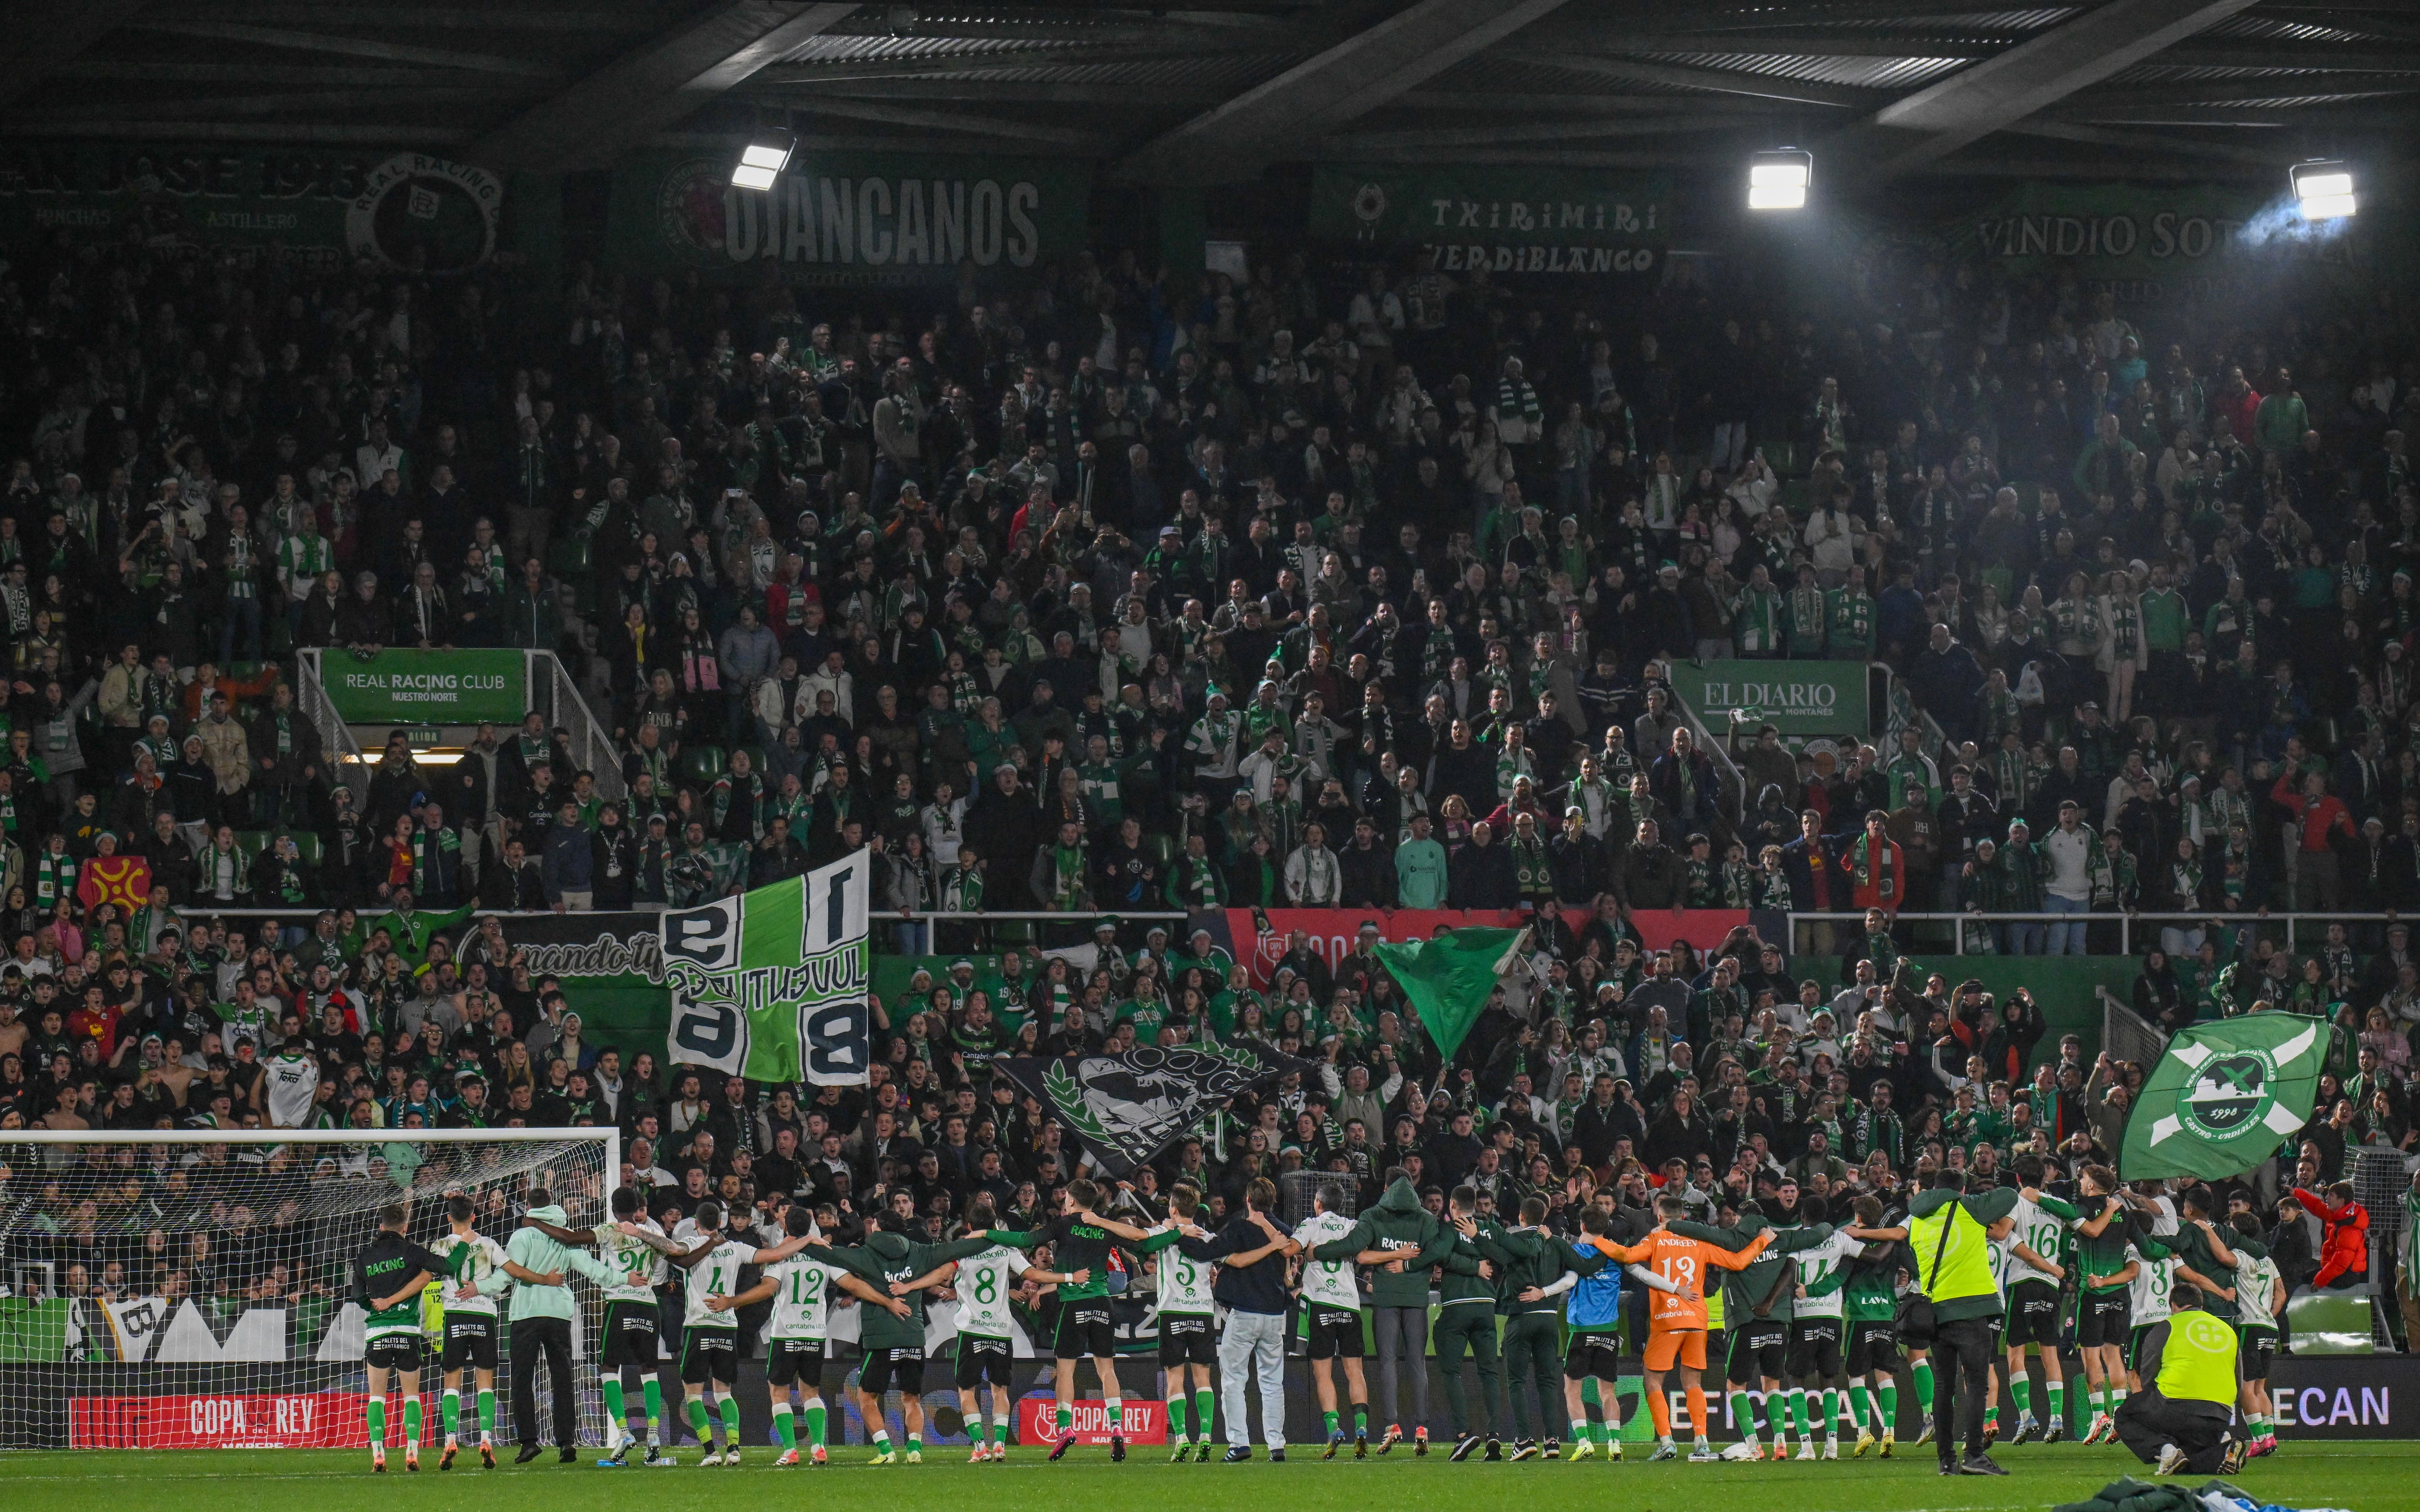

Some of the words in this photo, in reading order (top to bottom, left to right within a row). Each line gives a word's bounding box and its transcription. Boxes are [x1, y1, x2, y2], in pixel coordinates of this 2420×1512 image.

[347, 674, 387, 688] REAL
[392, 674, 457, 691] RACING
[463, 675, 504, 689] CLUB
[392, 692, 430, 701] NUESTRO
[431, 692, 457, 702] NORTE
[1704, 683, 1738, 706] EL
[1742, 683, 1836, 707] DIARIO
[408, 731, 437, 742] ALIDA
[2210, 1107, 2238, 1119] 1998
[2218, 1114, 2260, 1139] URDIALES
[1070, 1225, 1105, 1240] RACING
[1657, 1239, 1698, 1247] ANDREEV
[2028, 1223, 2058, 1259] 16
[365, 1256, 406, 1277] RACING
[1176, 1252, 1196, 1286] 5
[1661, 1256, 1696, 1287] 13
[2151, 1259, 2168, 1296] 3
[707, 1267, 726, 1294] 4
[790, 1268, 824, 1305] 12
[975, 1268, 996, 1304] 8
[2256, 1273, 2269, 1307] 7
[1655, 1310, 1682, 1320] cantabria
[191, 1400, 243, 1435] COPA
[276, 1398, 313, 1434] REY
[1125, 1408, 1151, 1432] REY
